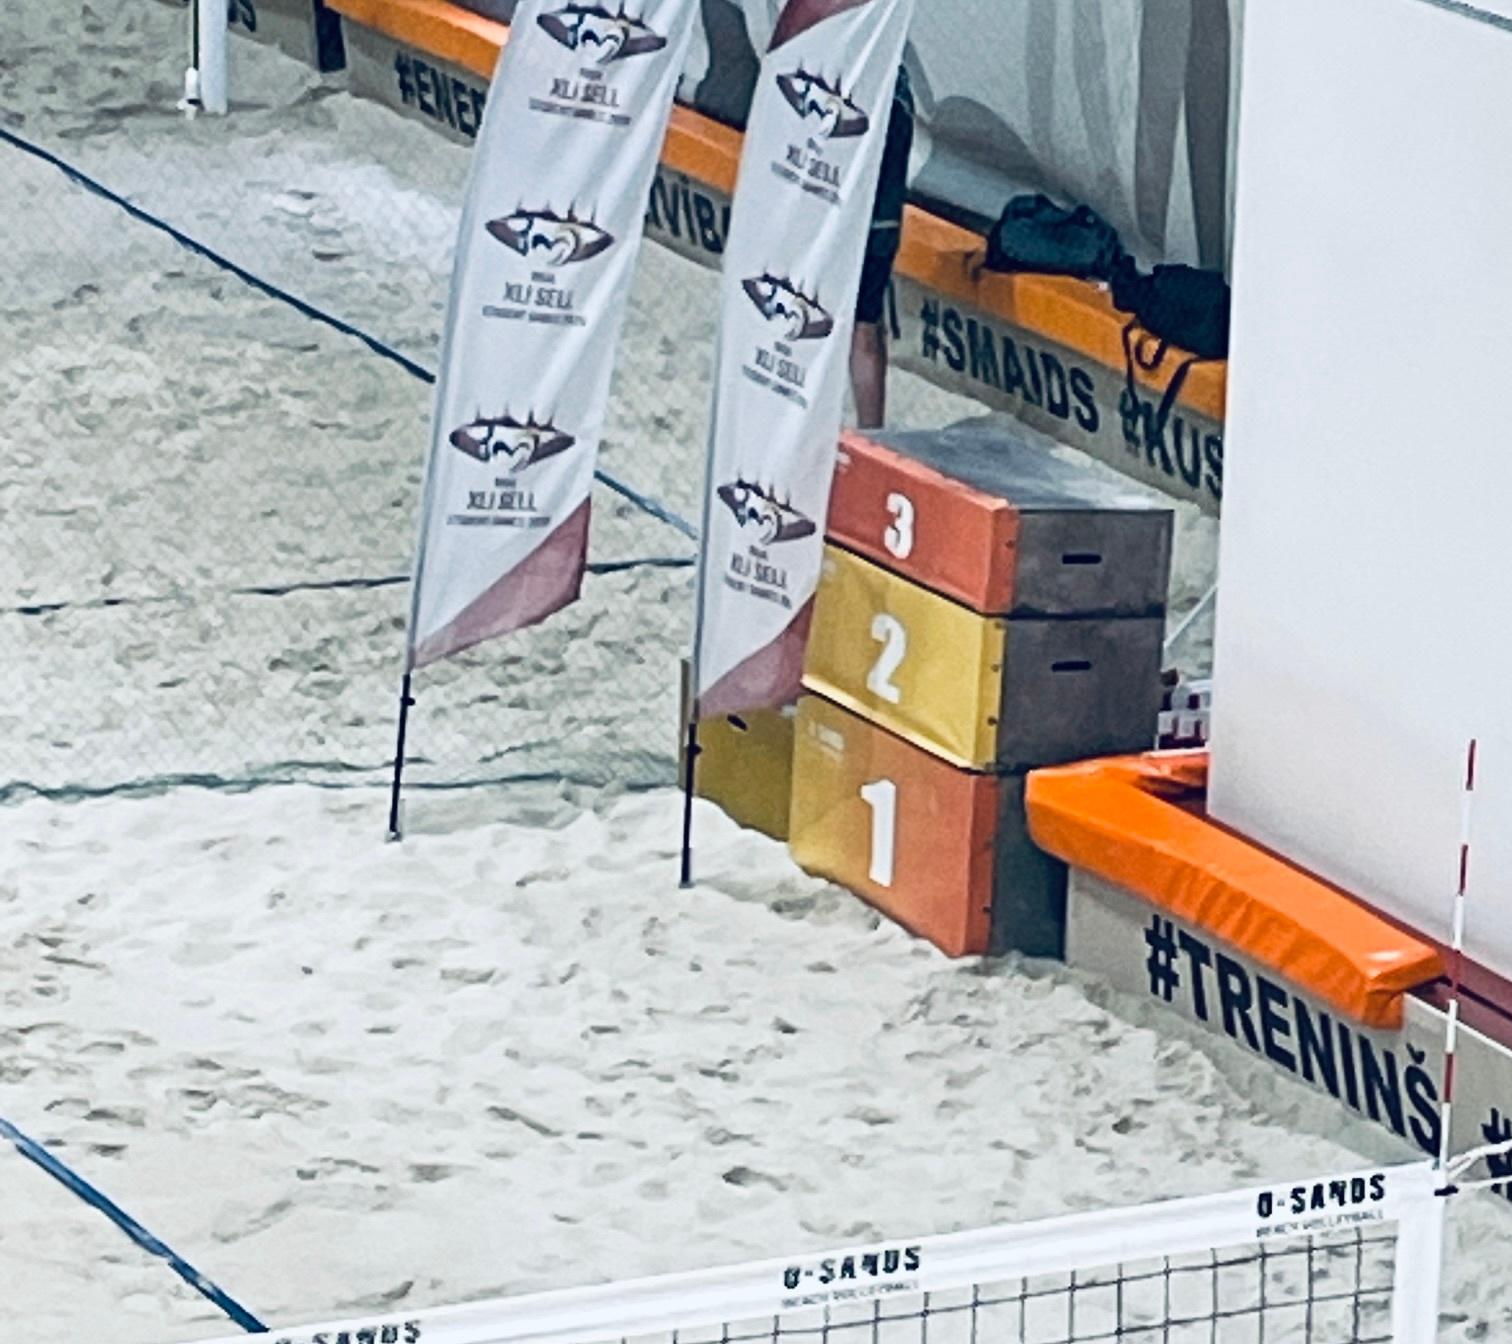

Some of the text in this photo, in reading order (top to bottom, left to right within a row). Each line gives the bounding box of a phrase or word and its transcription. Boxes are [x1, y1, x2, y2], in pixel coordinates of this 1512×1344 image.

[920, 297, 1099, 433] #SMAIDS
[884, 492, 915, 559] 3
[867, 613, 907, 704] 2
[861, 778, 897, 887] 1
